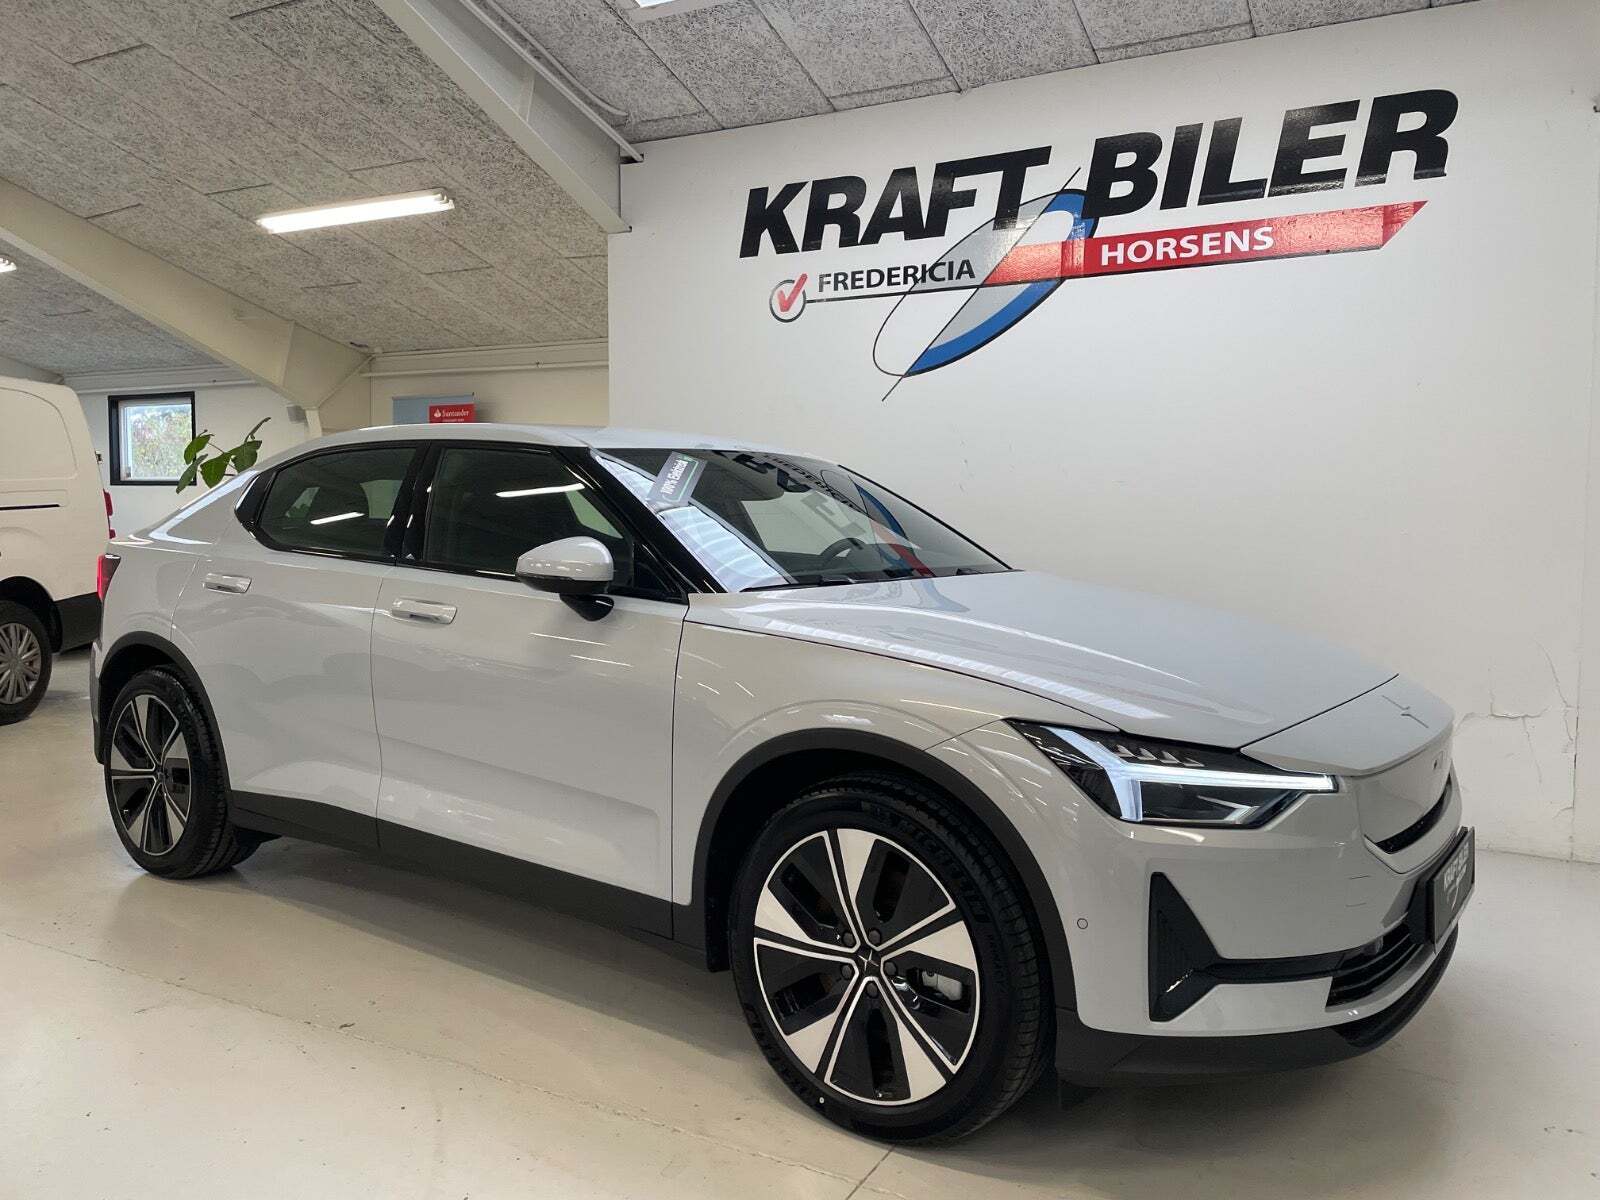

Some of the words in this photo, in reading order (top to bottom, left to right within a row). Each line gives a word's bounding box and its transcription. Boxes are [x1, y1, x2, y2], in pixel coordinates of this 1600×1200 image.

[739, 146, 1050, 258] KRAFT
[1081, 88, 1459, 217] BILER
[1100, 226, 1275, 266] HORSENS
[818, 258, 976, 293] FREDERICIA
